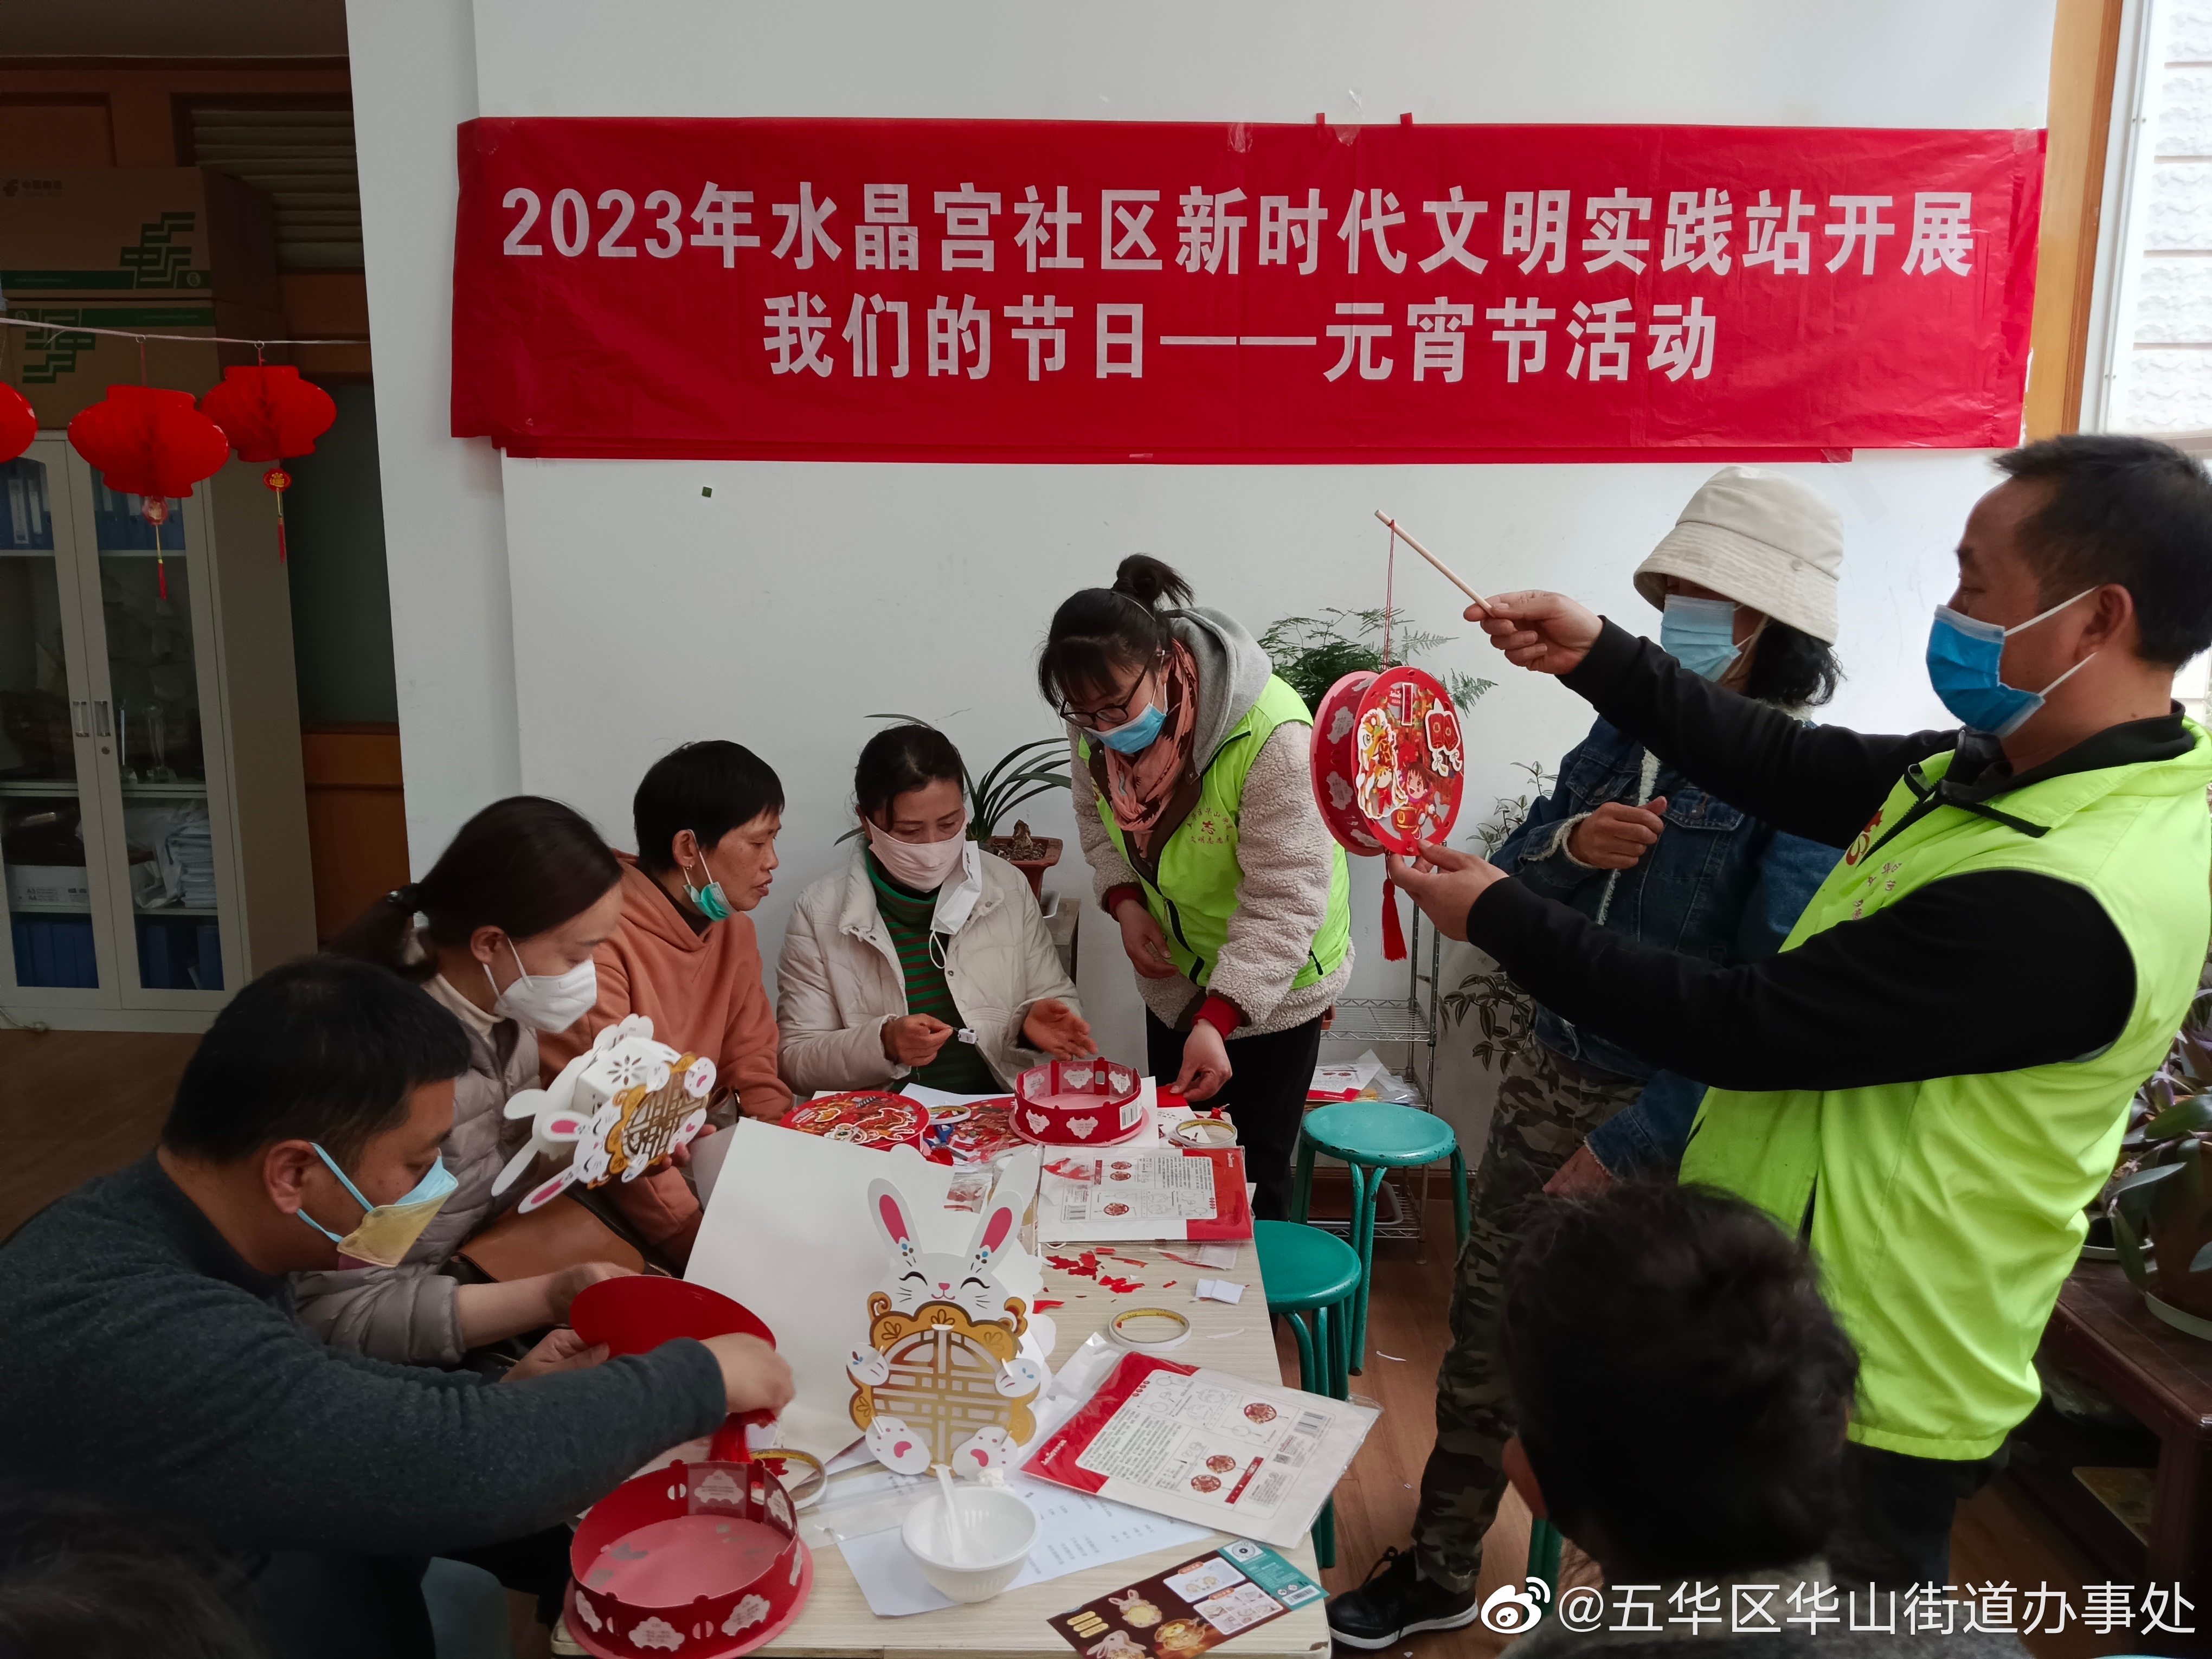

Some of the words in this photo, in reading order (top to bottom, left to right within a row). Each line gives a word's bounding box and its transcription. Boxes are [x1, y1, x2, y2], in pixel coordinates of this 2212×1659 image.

[502, 182, 1973, 275] 2023年水晶宫社区新时代文明实践站开展
[763, 292, 1716, 383] 我们的节日——元宵节活动
